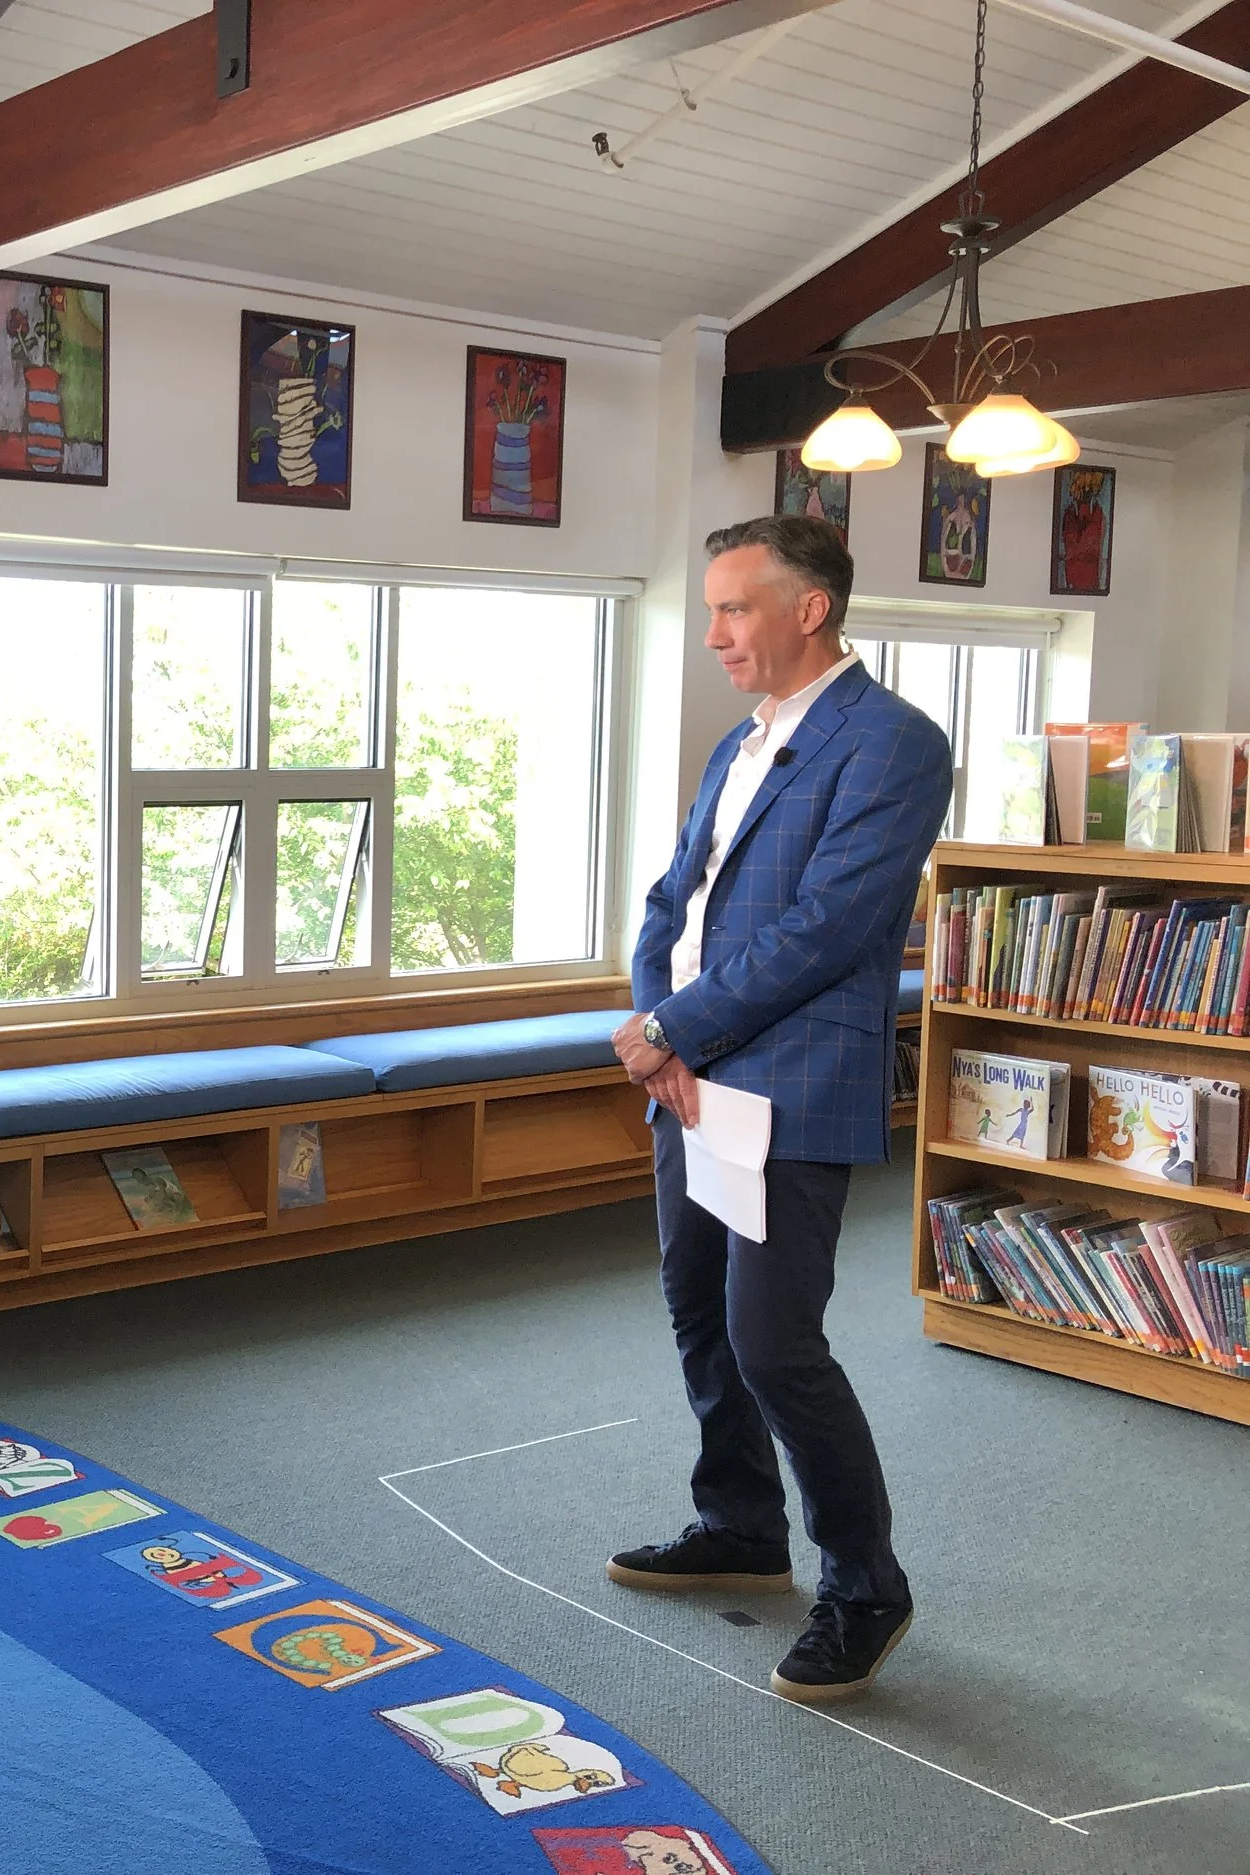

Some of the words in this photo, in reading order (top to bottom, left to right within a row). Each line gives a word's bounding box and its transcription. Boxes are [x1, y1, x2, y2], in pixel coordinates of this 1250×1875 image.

[952, 1056, 981, 1078] NYA'S
[983, 1062, 1009, 1085] LONG
[1012, 1068, 1045, 1092] WALK
[1096, 1072, 1134, 1093] HELLO
[1140, 1081, 1184, 1106] HELLO
[402, 1694, 546, 1747] D
